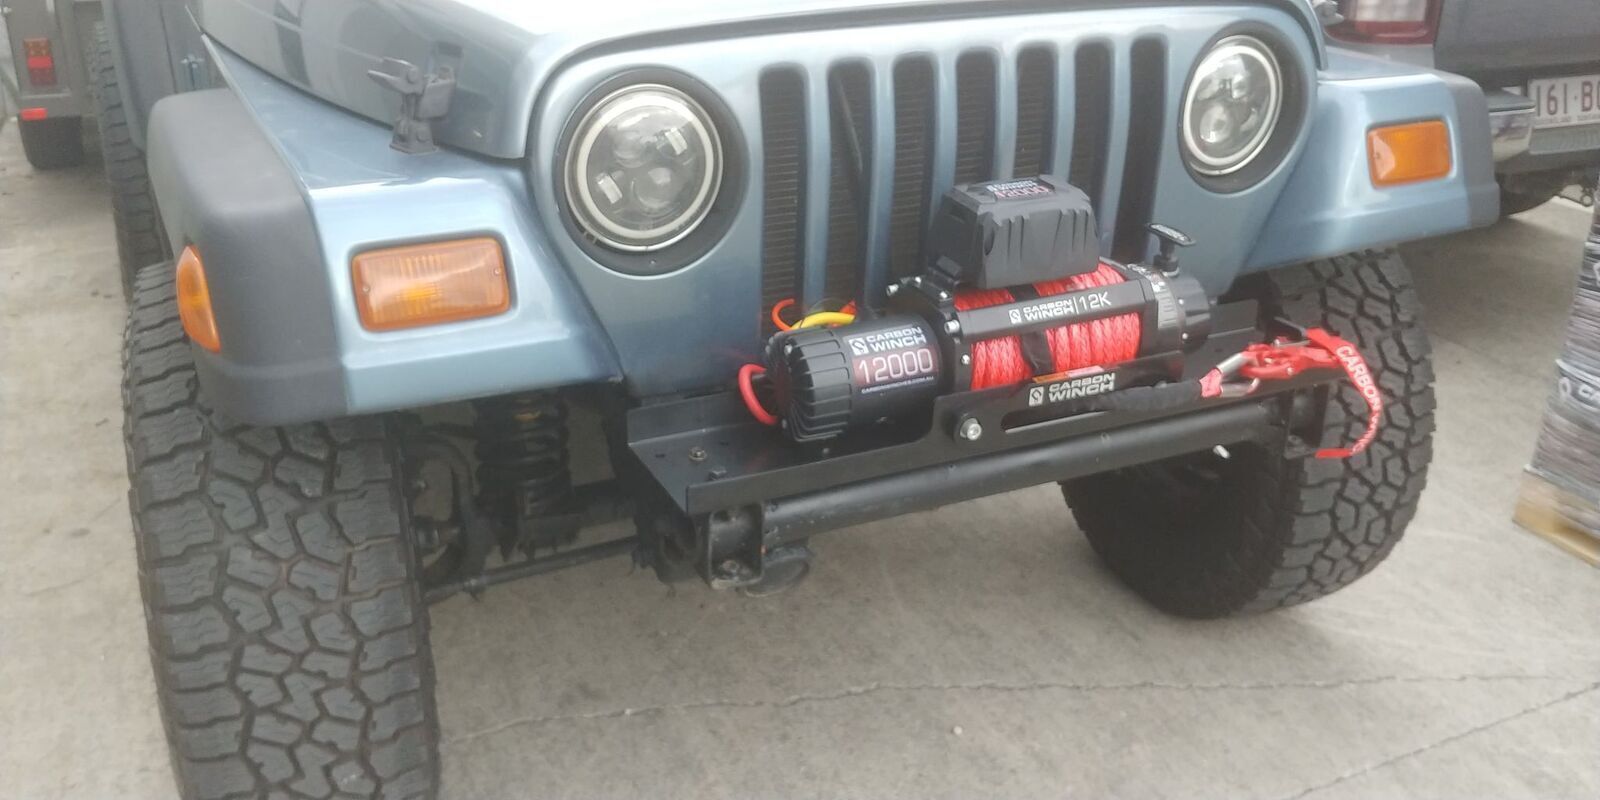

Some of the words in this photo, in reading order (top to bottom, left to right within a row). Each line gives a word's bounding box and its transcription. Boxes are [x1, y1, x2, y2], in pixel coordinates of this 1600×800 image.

[1023, 299, 1073, 313] CARBON
[1079, 291, 1112, 311] 12K
[1024, 305, 1076, 321] WINCH
[866, 326, 923, 343] CARBON
[869, 334, 927, 352] WINCH
[859, 348, 933, 383] 12000
[1049, 372, 1116, 392] CARBON
[1048, 382, 1115, 402] WINCH
